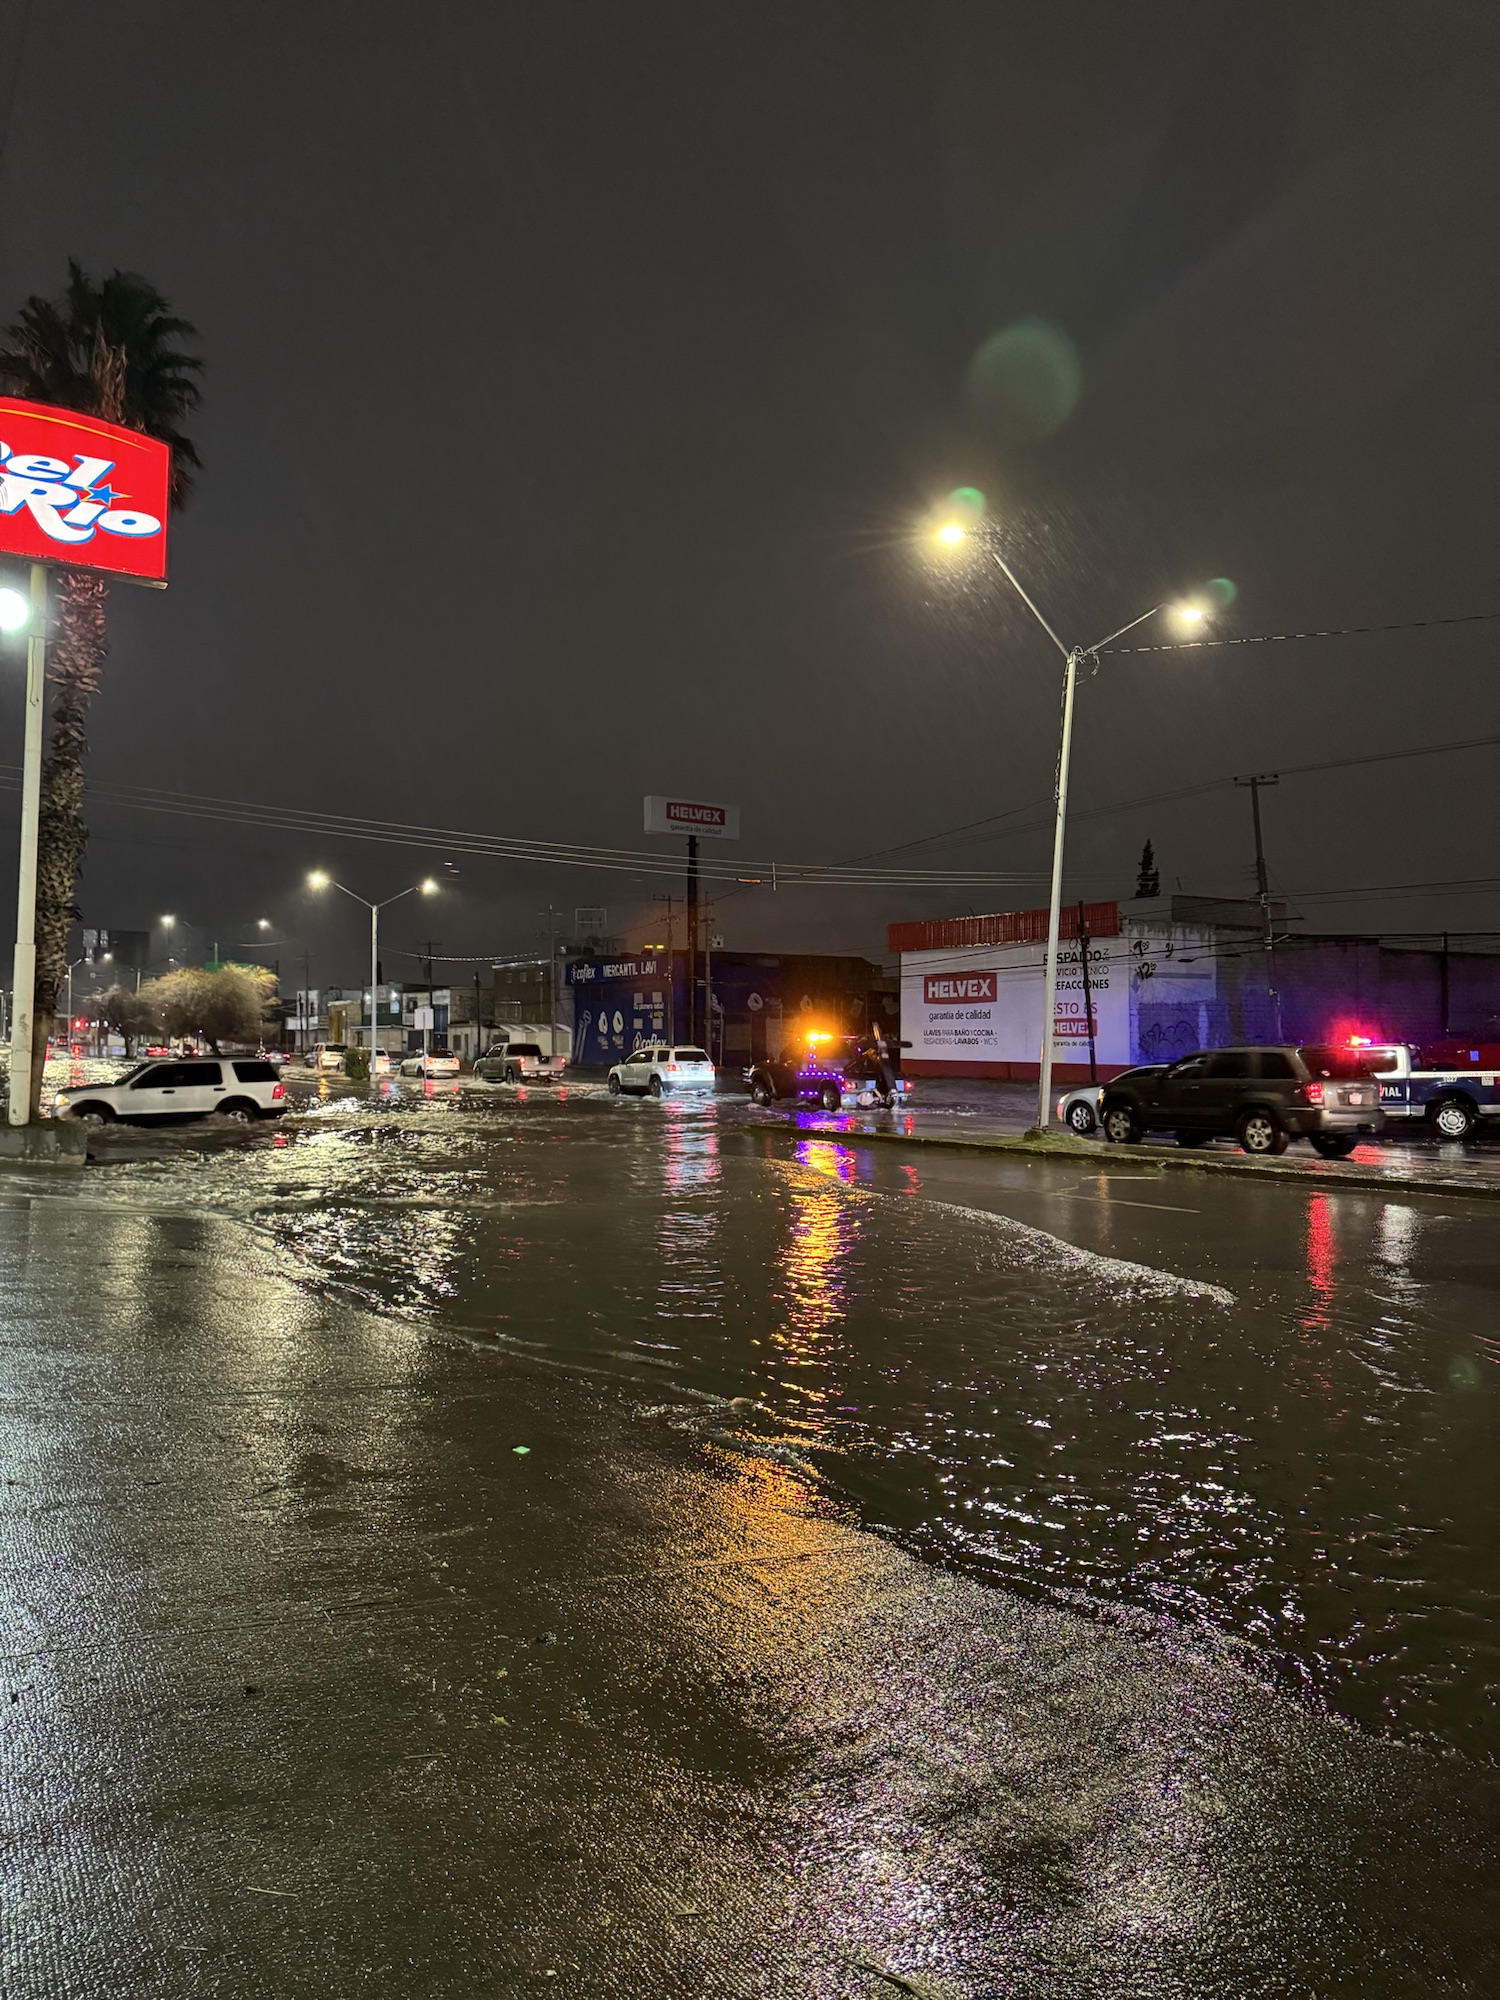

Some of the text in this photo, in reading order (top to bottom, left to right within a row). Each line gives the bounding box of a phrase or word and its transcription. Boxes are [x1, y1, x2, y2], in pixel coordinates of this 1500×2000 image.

[670, 805, 721, 823] HELVEX
[702, 827, 722, 835] calidad
[1043, 950, 1102, 965] RSPALDO
[577, 963, 597, 983] coflex
[602, 962, 638, 978] MERCANTIL
[1043, 967, 1077, 977] SVICIO
[928, 978, 992, 999] HELVEX
[1053, 1002, 1079, 1014] STO
[954, 1010, 964, 1020] de
[965, 1009, 991, 1020] calidad
[954, 1028, 970, 1036] BAÑO
[954, 1037, 979, 1045] LAVABOS
